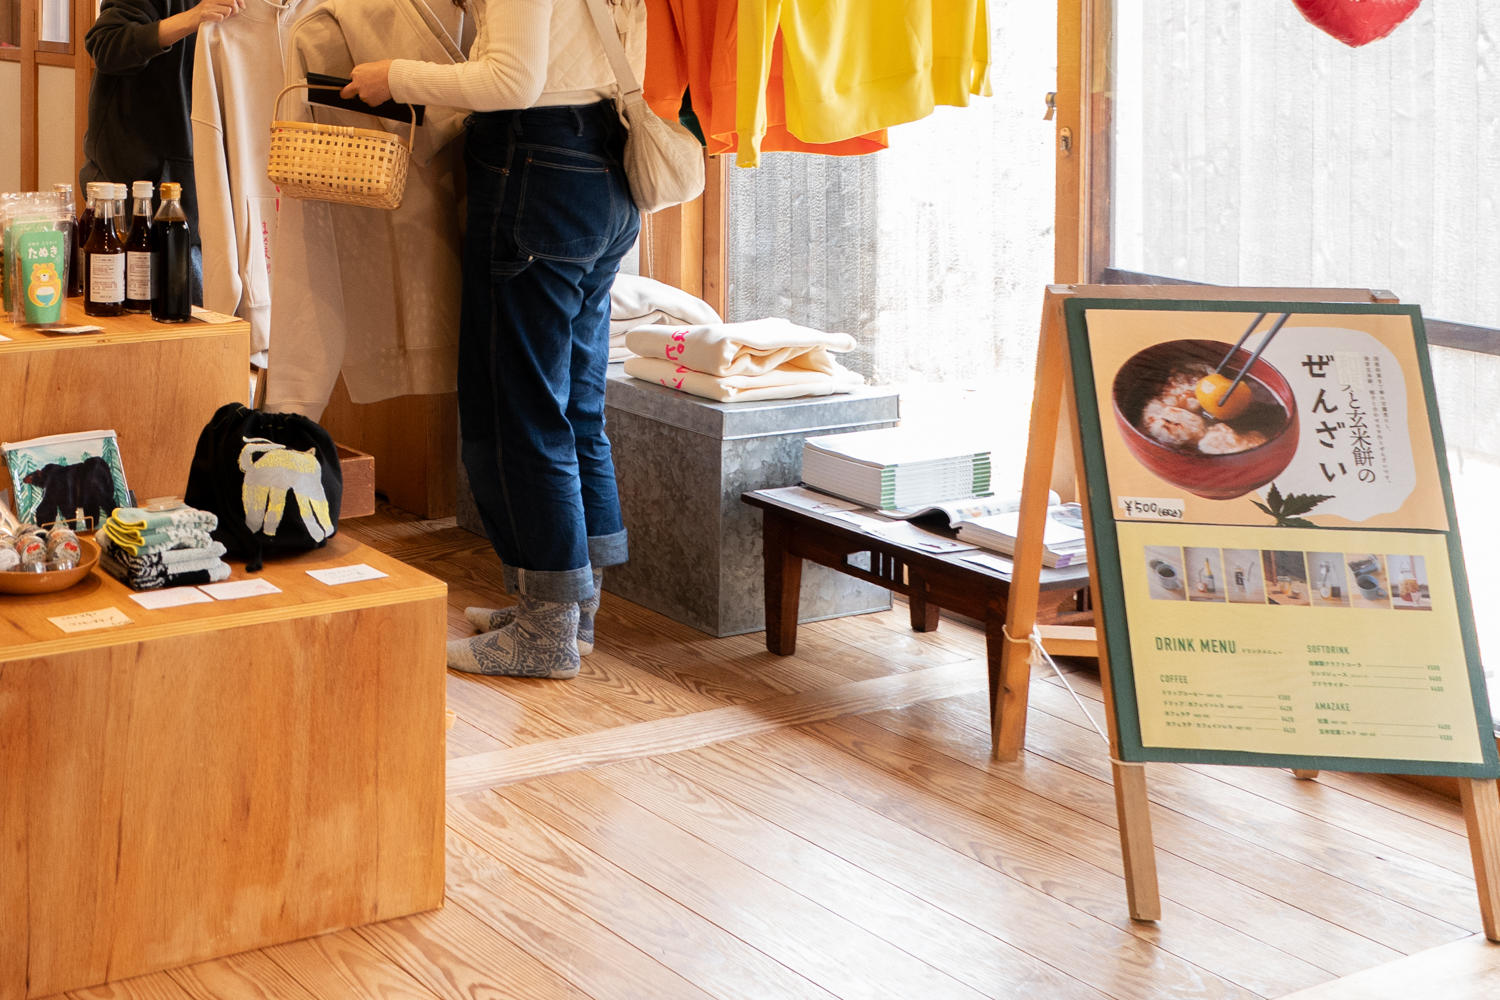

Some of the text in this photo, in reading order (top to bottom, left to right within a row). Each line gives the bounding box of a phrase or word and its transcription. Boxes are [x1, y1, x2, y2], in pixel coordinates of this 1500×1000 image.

[28, 245, 58, 259] たぬき
[1301, 355, 1348, 482] ぜんざい
[1155, 636, 1196, 652] DRINK
[1200, 638, 1237, 654] MENU
[1306, 644, 1350, 654] SOFTDRINK
[1160, 674, 1188, 684] COFFEE
[1315, 702, 1351, 712] AMAZAKE
